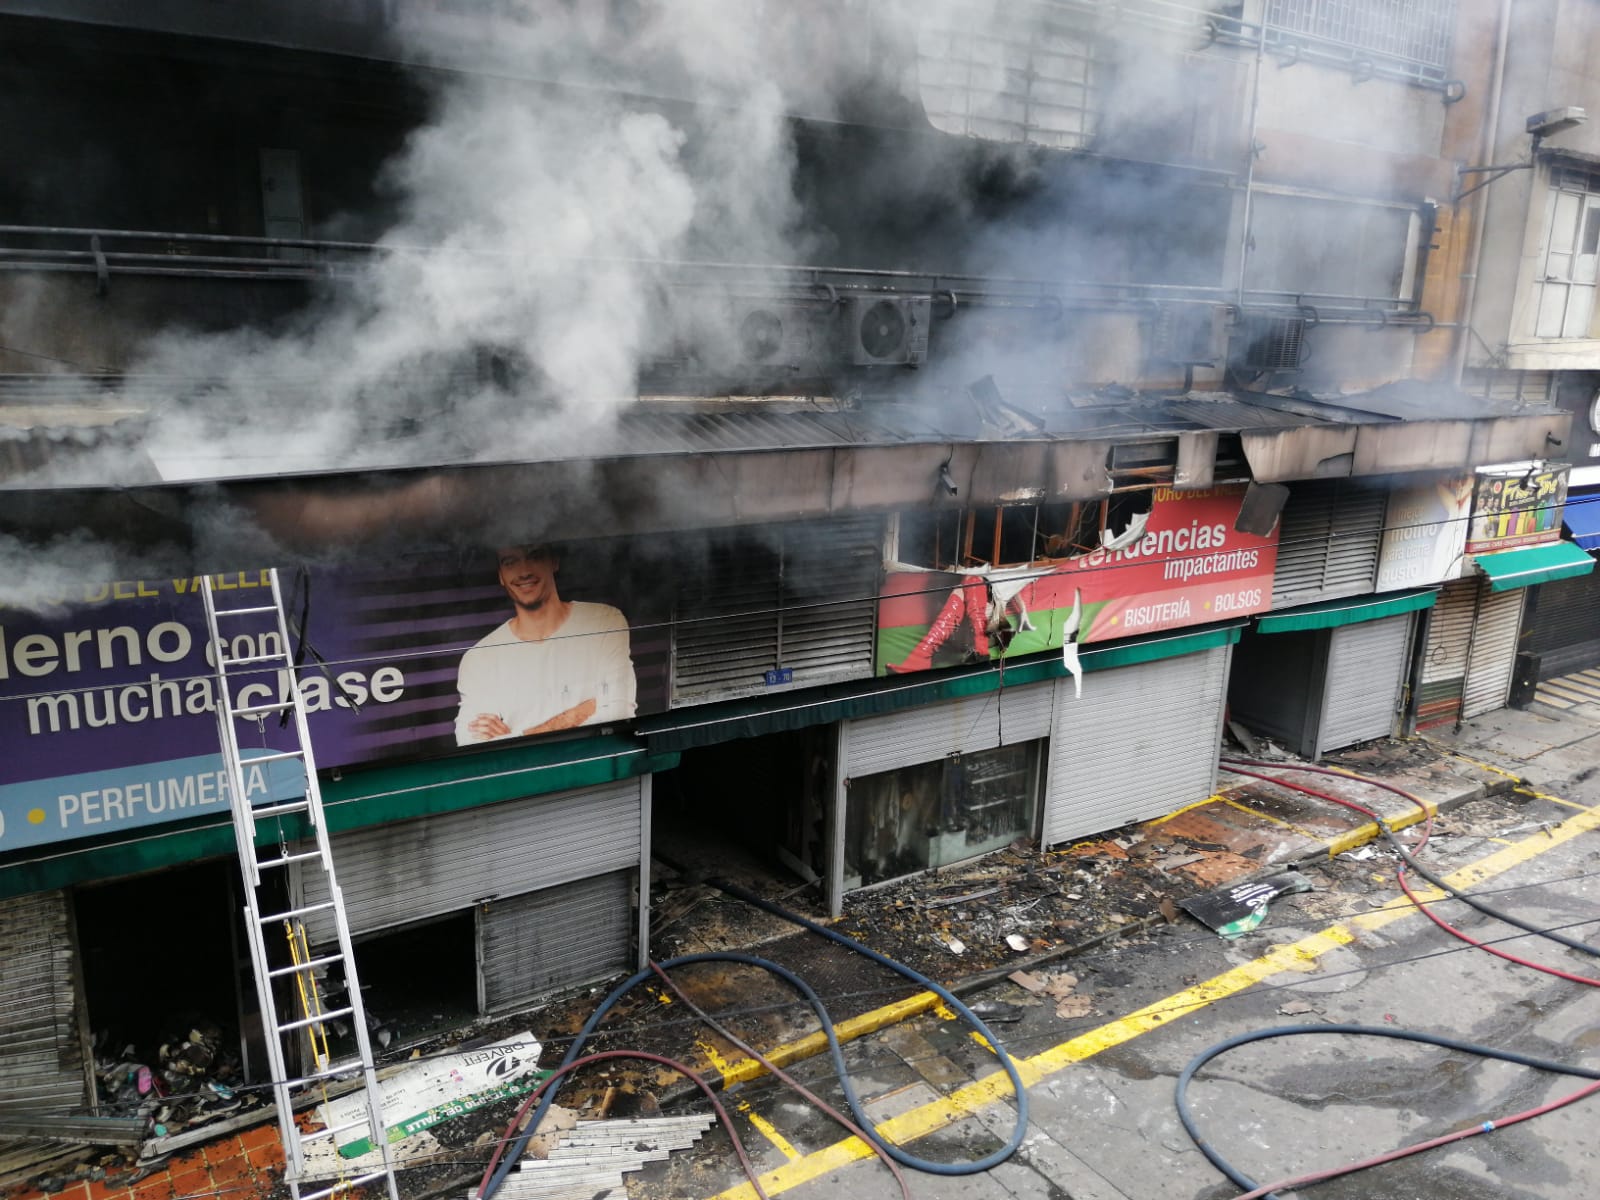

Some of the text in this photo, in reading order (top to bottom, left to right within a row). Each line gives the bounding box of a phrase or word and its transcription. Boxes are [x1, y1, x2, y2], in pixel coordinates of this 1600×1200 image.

[1164, 549, 1259, 581] impactantes
[1124, 588, 1262, 627] BISUTERÍA BOLSOS
[206, 632, 281, 667] con
[28, 667, 404, 734] mucha clase
[58, 765, 267, 829] PERFUMERA
[464, 1041, 525, 1067] DRIVEFIT
